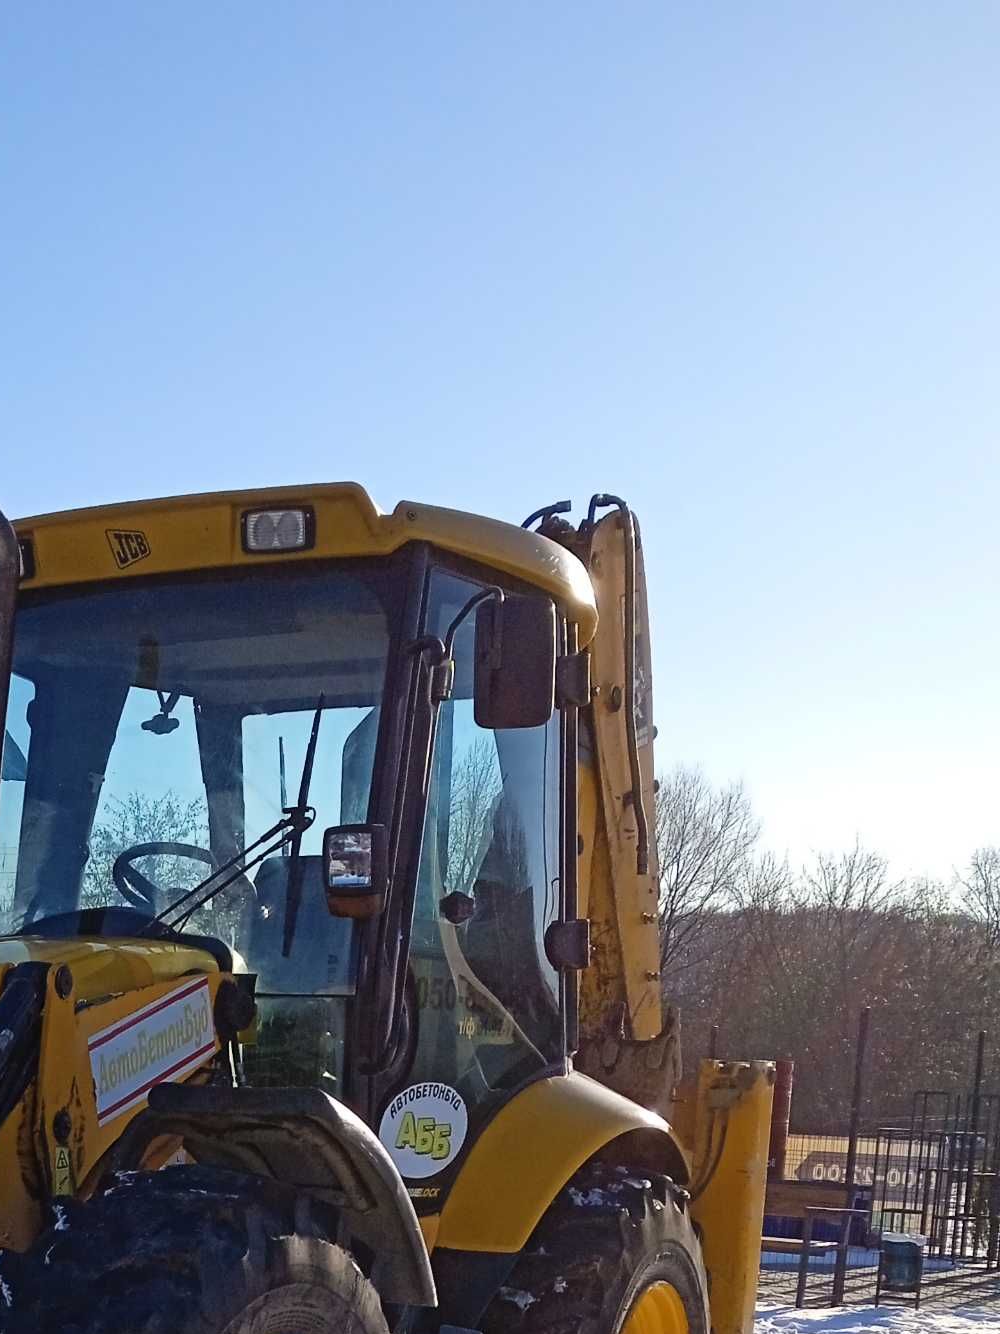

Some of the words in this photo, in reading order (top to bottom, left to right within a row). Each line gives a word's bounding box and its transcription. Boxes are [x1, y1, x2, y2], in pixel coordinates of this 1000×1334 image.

[113, 533, 148, 565] JCB
[98, 992, 209, 1095] АвтоБетонБуд
[390, 1084, 461, 1119] АВТОБЕТОНБУД
[395, 1111, 452, 1161] АББ
